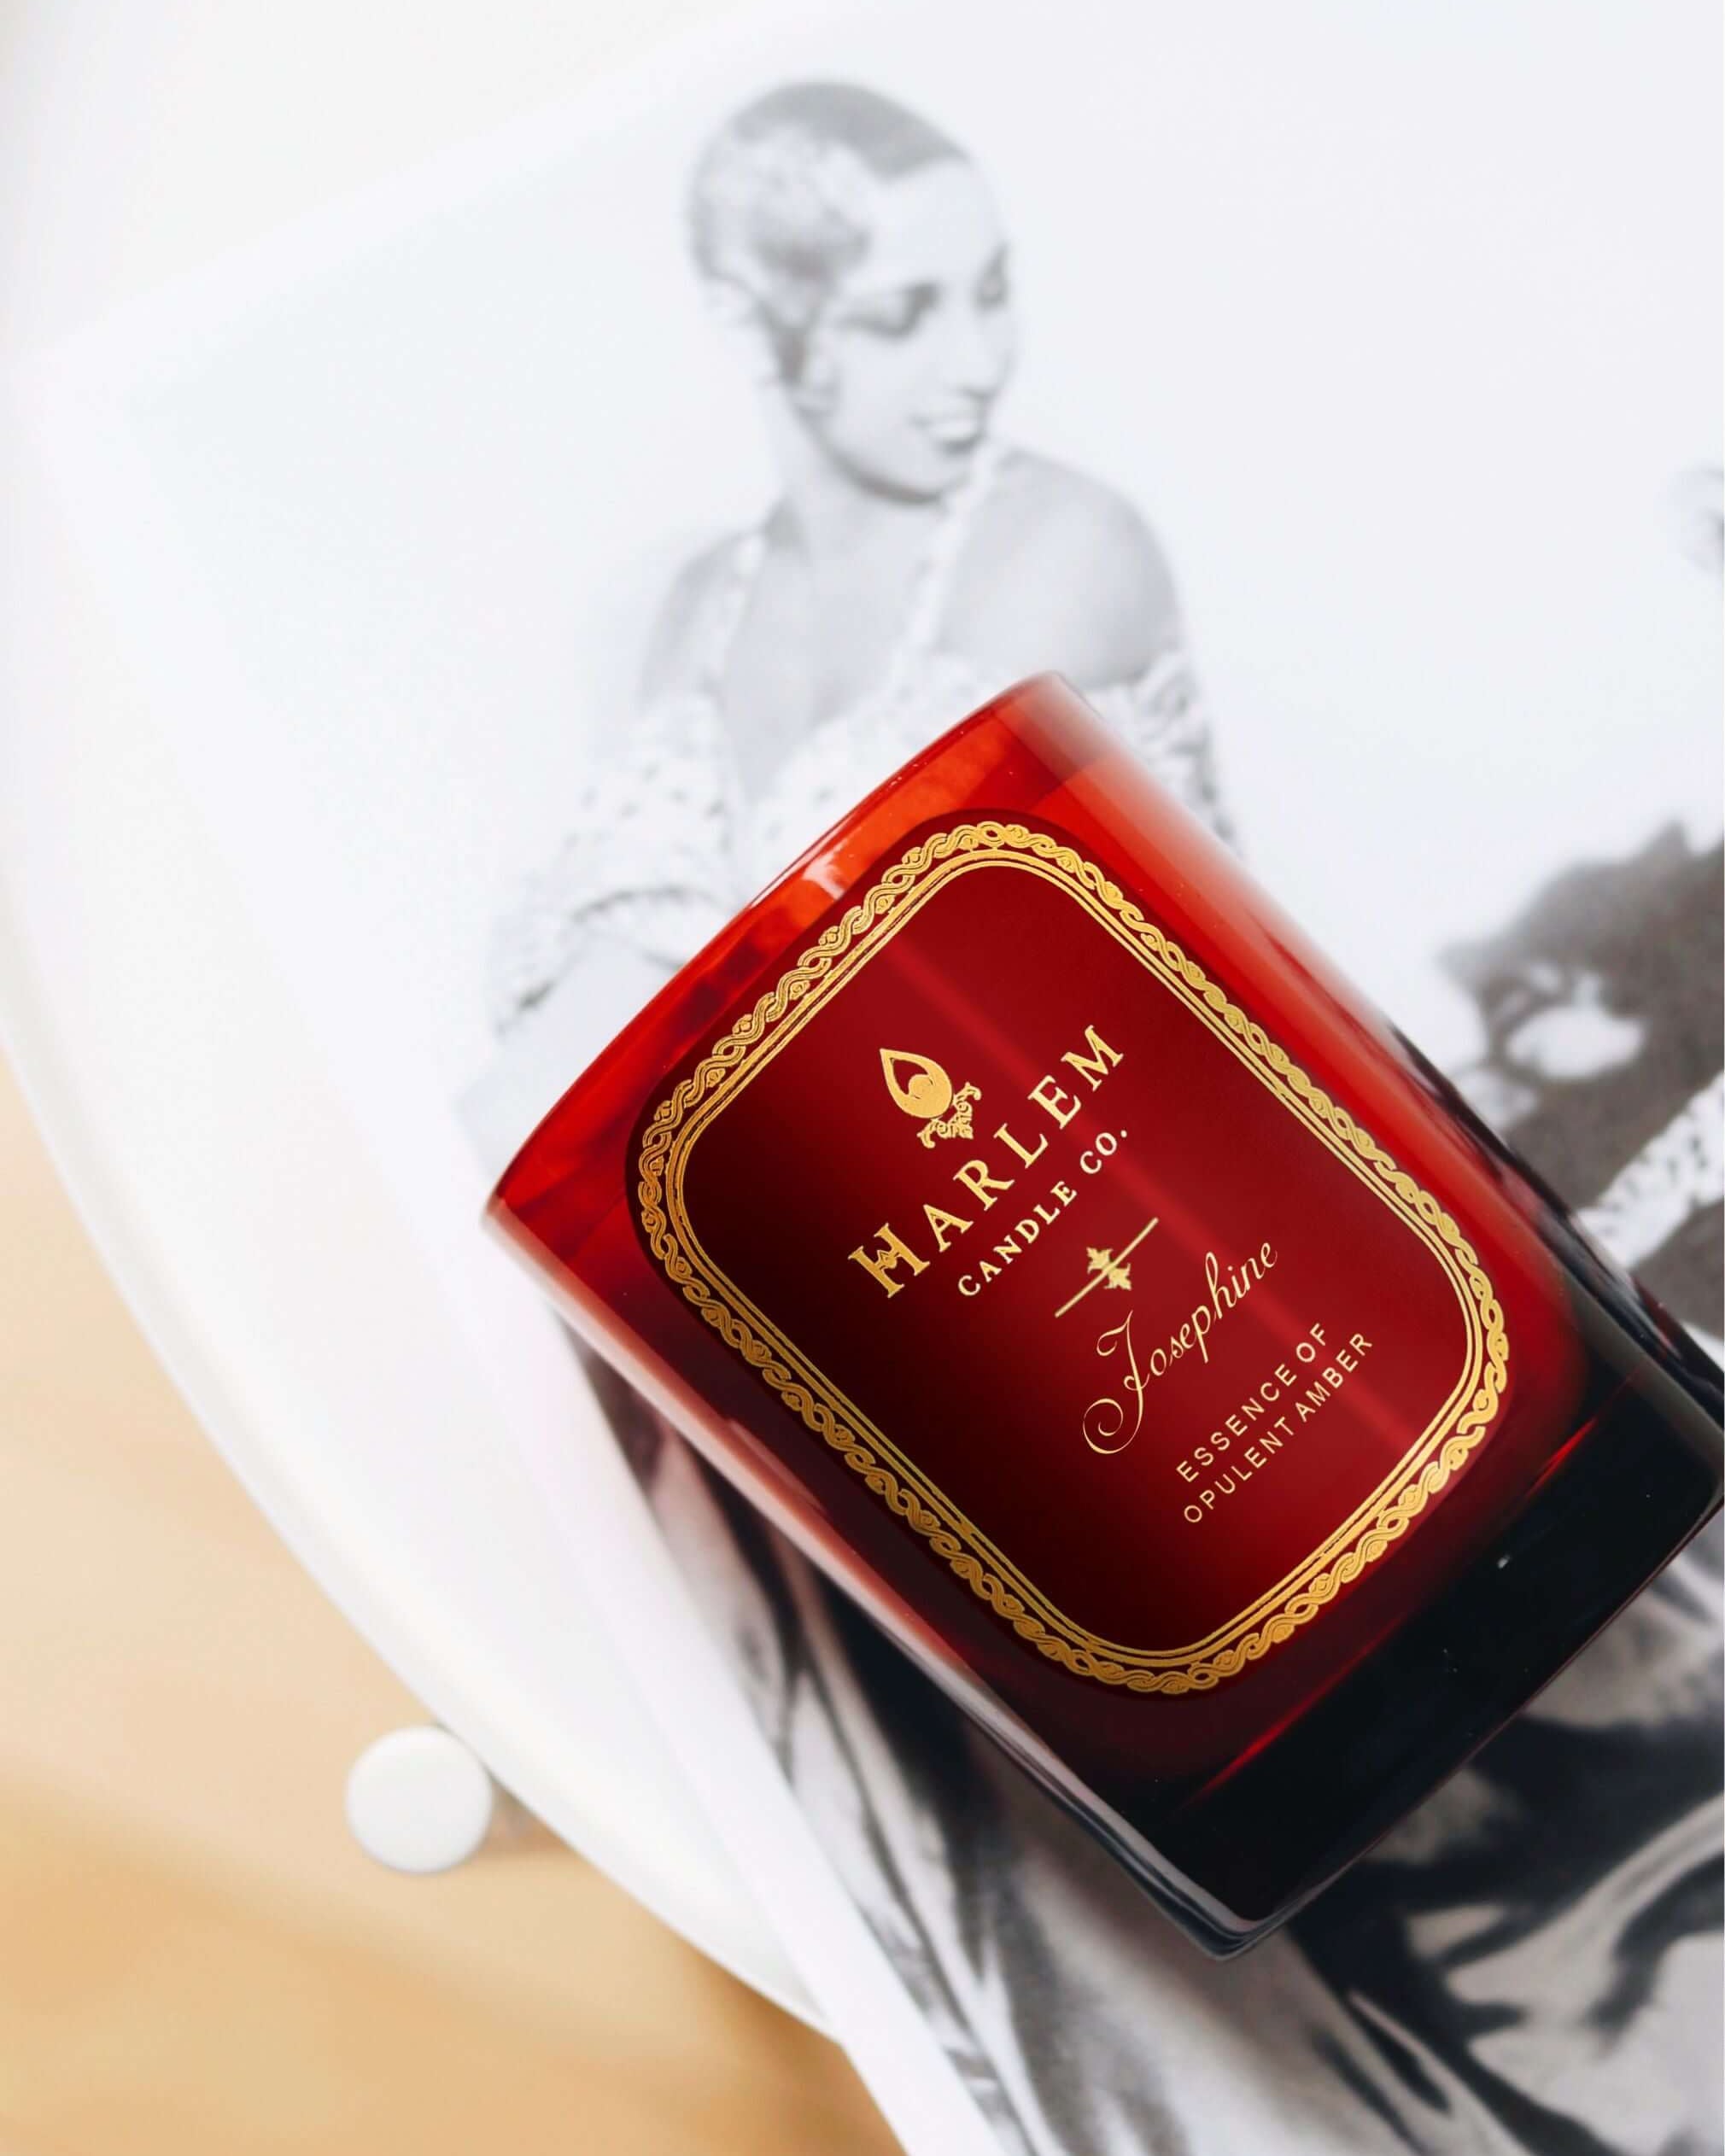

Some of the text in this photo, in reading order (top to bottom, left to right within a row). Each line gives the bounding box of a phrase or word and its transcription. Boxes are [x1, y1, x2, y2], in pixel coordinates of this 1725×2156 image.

[848, 1025, 1124, 1298] HARLEM
[957, 1127, 1128, 1296] CANDLE CO.
[1082, 1242, 1278, 1454] Josephine
[1175, 1323, 1327, 1483] ESSENCE OF
[1183, 1332, 1372, 1523] OPULENT AMBER
